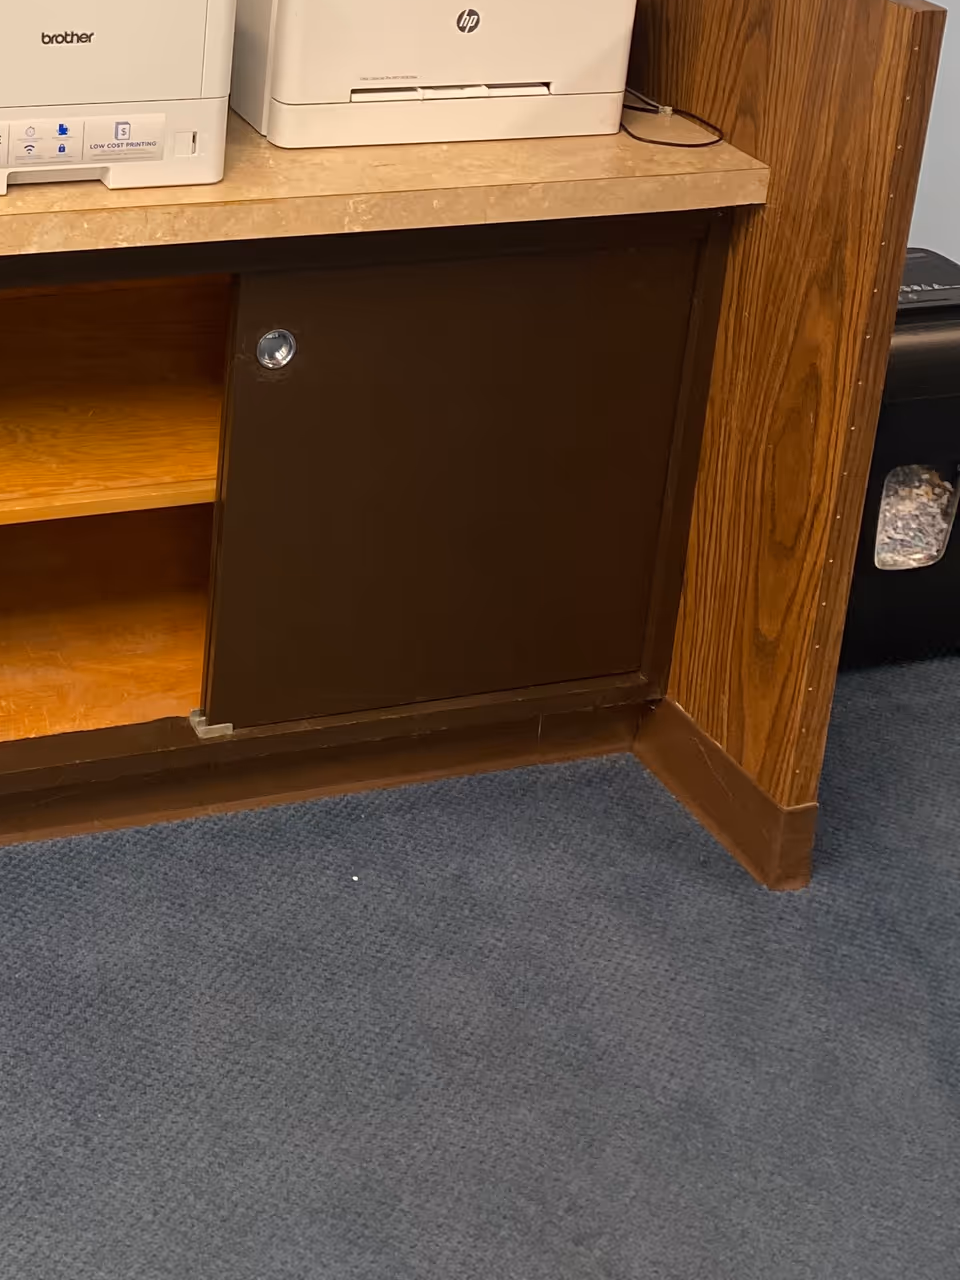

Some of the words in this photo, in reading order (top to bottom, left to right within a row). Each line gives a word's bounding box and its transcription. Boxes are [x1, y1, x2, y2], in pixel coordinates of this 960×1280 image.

[458, 9, 479, 33] hp
[41, 30, 94, 45] brother
[126, 140, 157, 148] PRINTING
